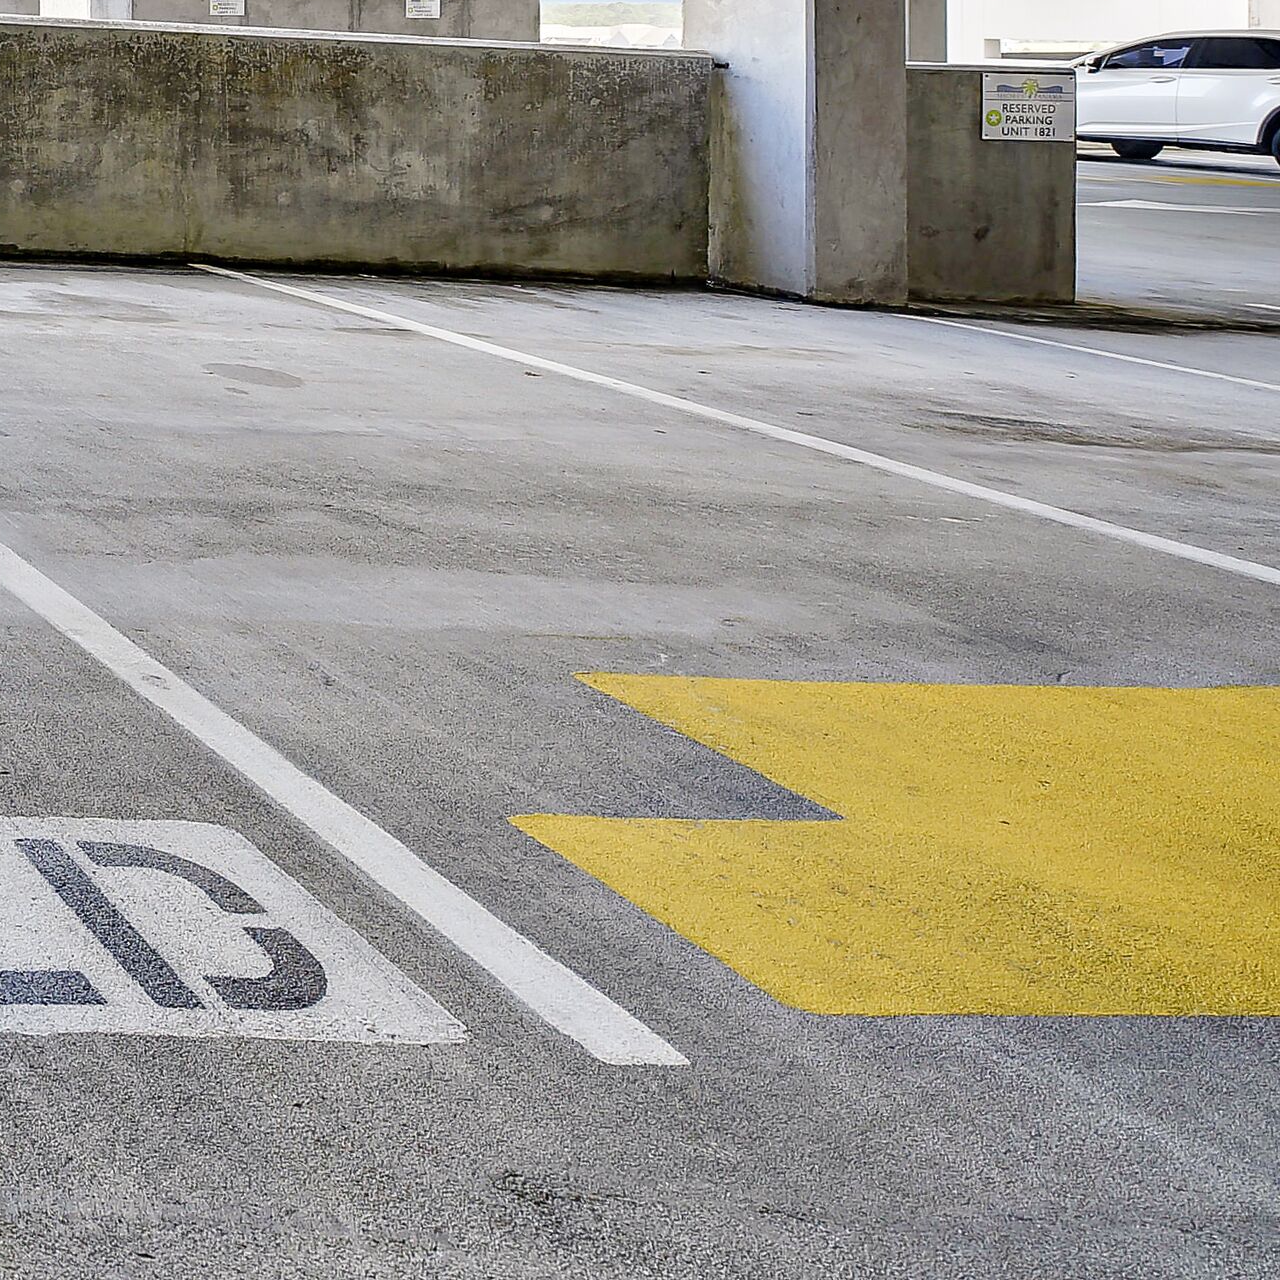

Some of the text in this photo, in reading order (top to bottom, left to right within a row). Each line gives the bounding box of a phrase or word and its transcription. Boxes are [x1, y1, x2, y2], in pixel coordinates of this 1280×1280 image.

[1002, 103, 1056, 114] RESERVED
[1005, 115, 1053, 125] PARKING
[1002, 127, 1056, 137] UNIT 1821
